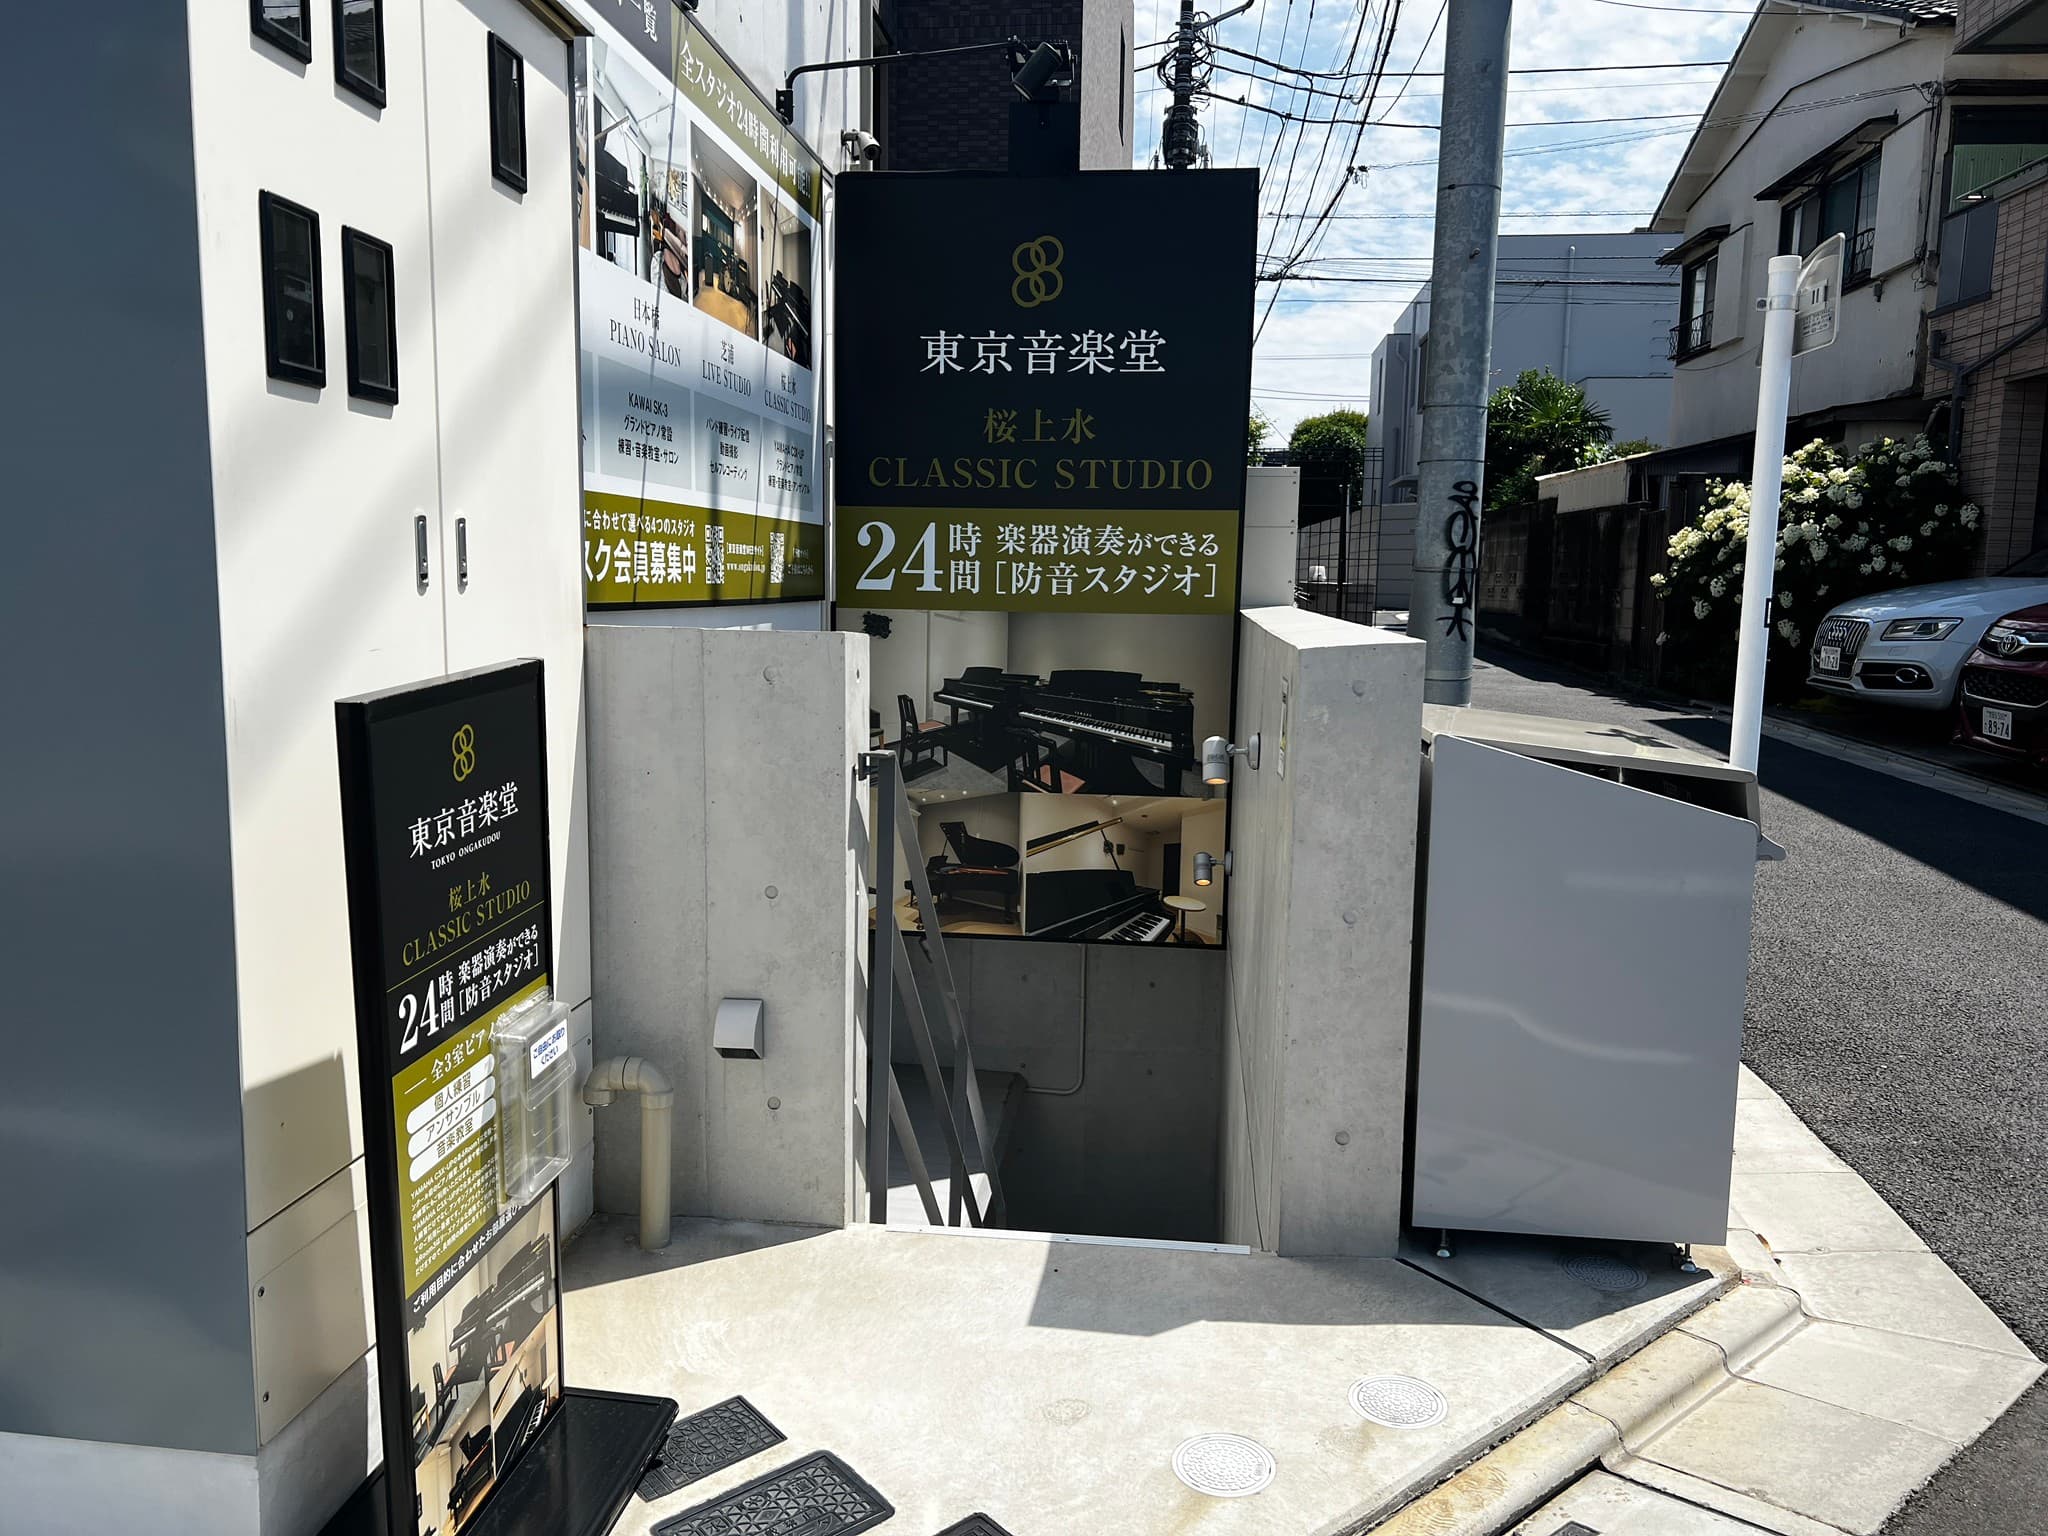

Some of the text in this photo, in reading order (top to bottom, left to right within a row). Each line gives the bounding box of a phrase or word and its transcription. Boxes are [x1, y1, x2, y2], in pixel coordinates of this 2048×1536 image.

[633, 296, 660, 331] 日本橋
[609, 319, 681, 367] PIANO SALON
[919, 328, 1167, 375] 東京音楽堂
[702, 359, 752, 397] LIVE STUDIO
[628, 391, 669, 418] KAWAI SK-3
[764, 389, 812, 424] CLASSIC STUDIO
[623, 414, 673, 443] グランドピアノ常設
[983, 407, 1097, 445] 桜上水
[868, 456, 1214, 491] CLASSIC STUDIO
[996, 523, 1220, 558] 楽器演奏ができる
[407, 781, 519, 859] 東京音楽堂
[430, 831, 501, 870] TOKYO ONGAKUDOU
[448, 871, 491, 913] 桜上水
[402, 879, 531, 967] CLASSIC STUDIO
[457, 924, 539, 987] 楽器演奏ができる
[433, 1071, 472, 1112] 個人練習
[425, 1091, 481, 1143] アンサンブル
[436, 1117, 474, 1159] 音楽教室
[412, 1204, 522, 1314] ご利用目的に合わせたお部屋選び
